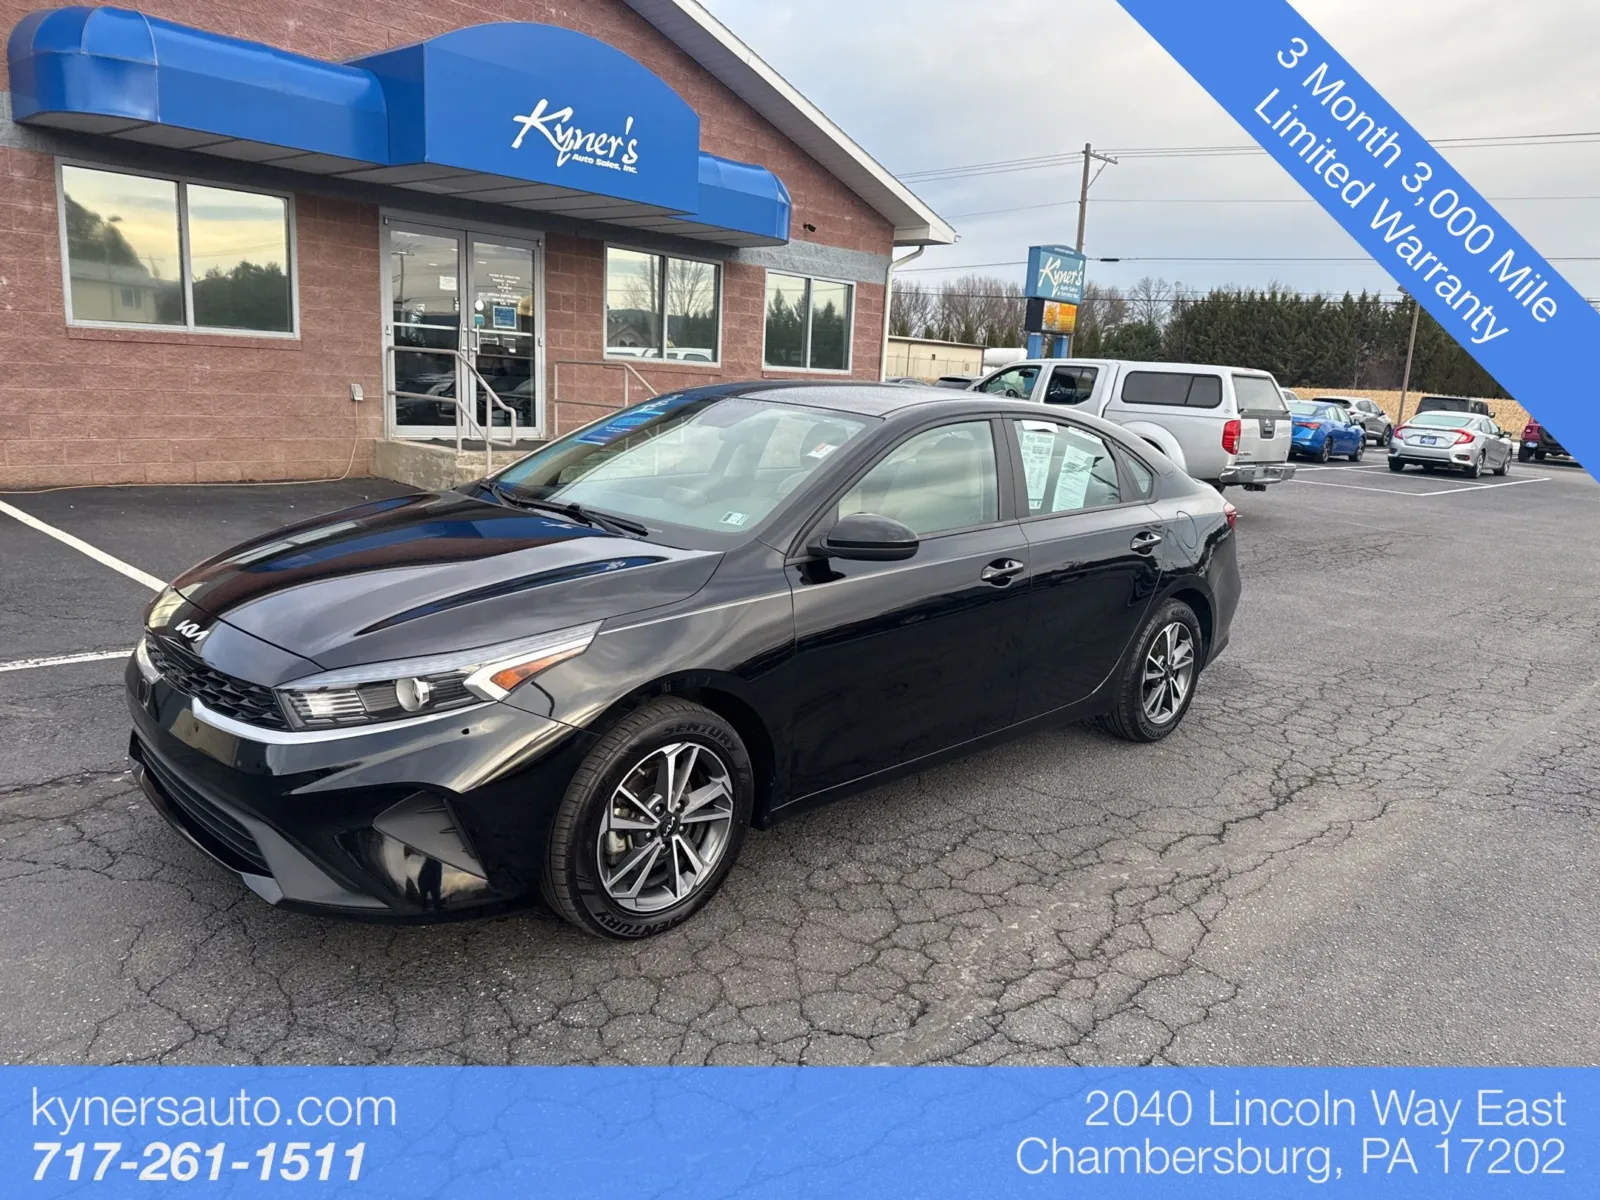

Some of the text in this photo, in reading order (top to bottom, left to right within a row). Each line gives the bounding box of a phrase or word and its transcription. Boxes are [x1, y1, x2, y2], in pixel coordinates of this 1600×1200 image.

[511, 98, 639, 167] Kyner's
[572, 153, 593, 164] Auto
[623, 164, 638, 174] Inc.
[1038, 256, 1083, 298] Kyner's
